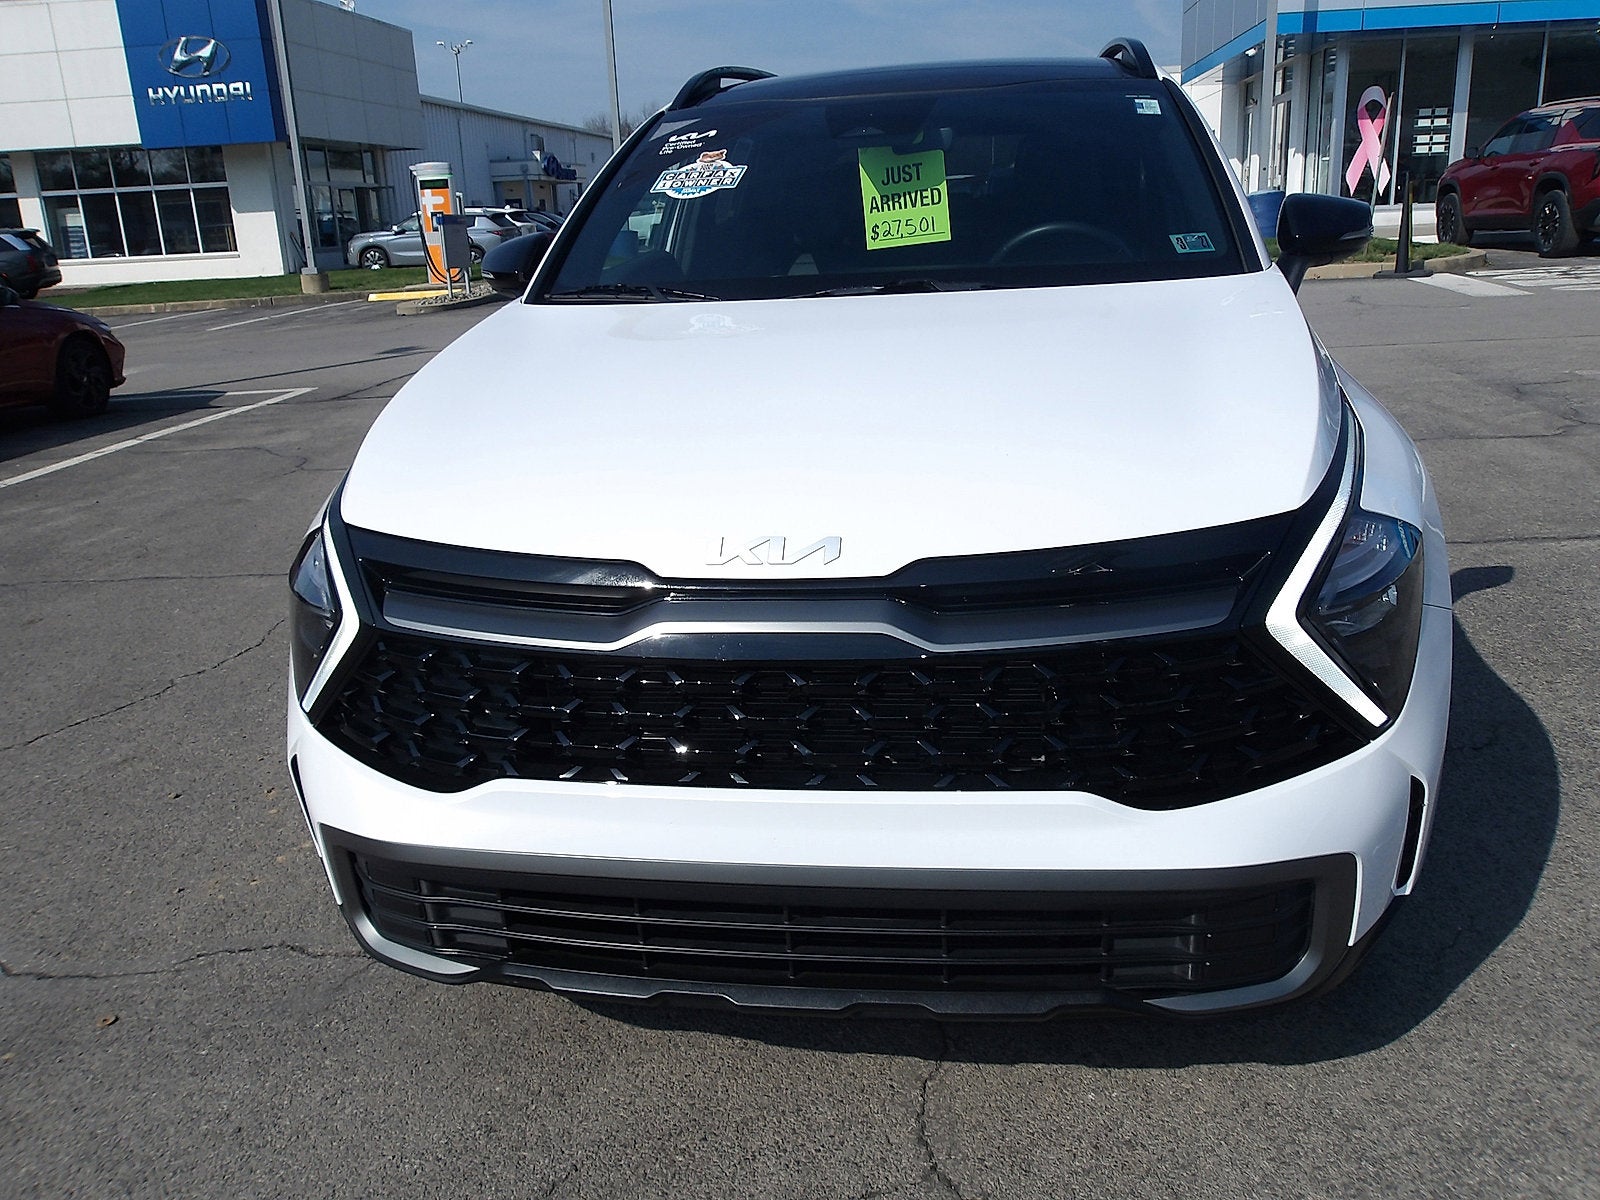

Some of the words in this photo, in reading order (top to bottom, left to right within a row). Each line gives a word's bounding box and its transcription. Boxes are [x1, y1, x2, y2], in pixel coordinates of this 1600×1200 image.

[147, 81, 253, 105] HYUNDAI
[661, 142, 702, 151] Pre-Owned
[664, 169, 738, 181] CARFAX
[671, 177, 734, 188] OWNER
[881, 162, 923, 186] JUST
[869, 187, 943, 214] ARRIVED
[870, 216, 935, 242] $27,501
[1175, 236, 1188, 250] 3
